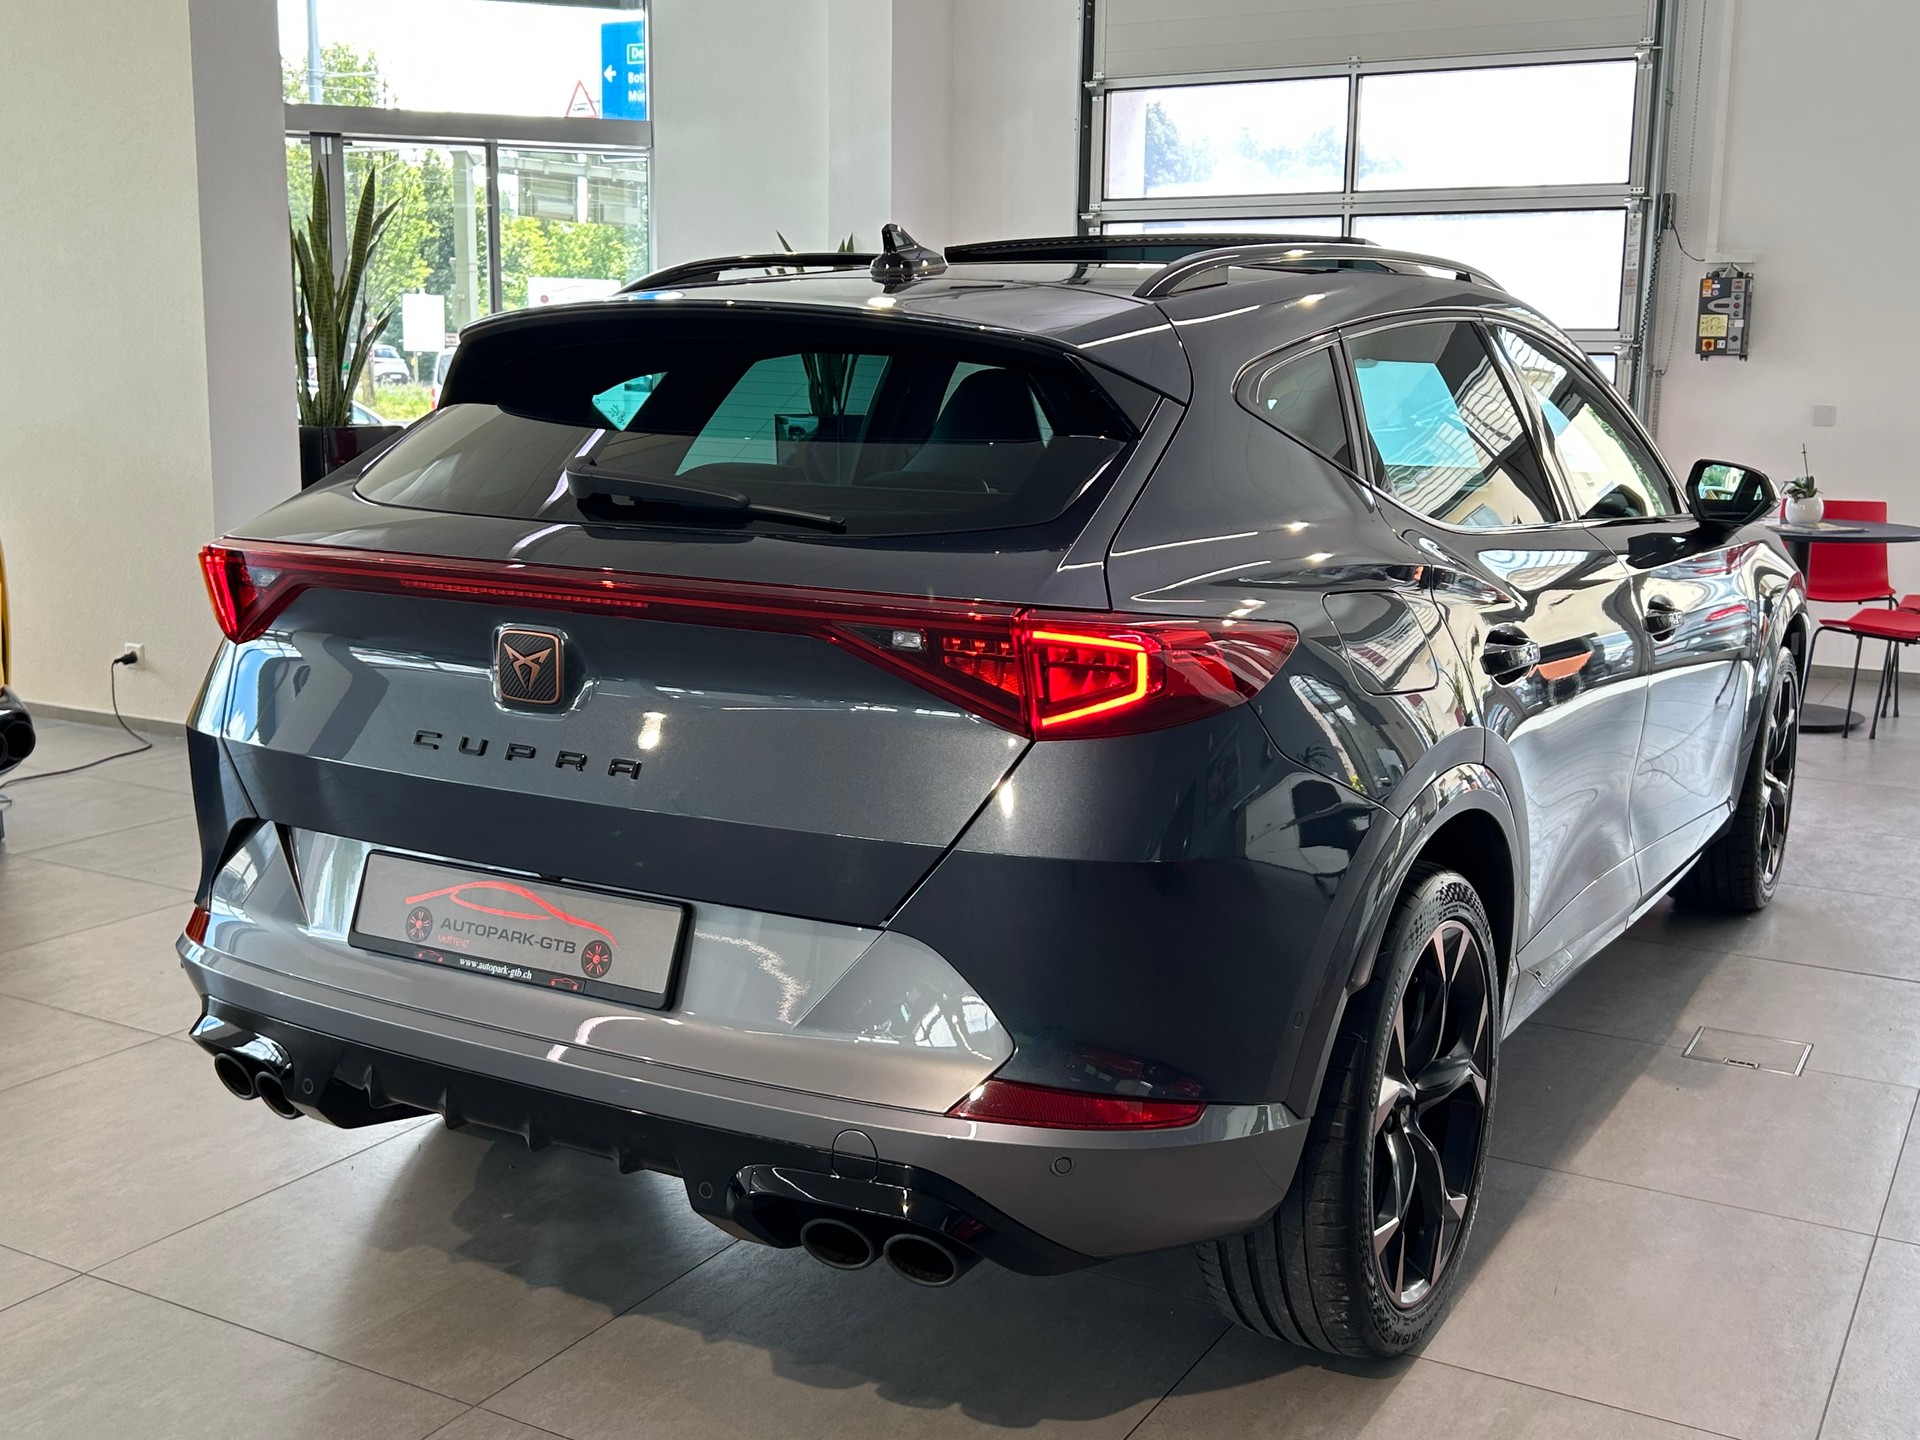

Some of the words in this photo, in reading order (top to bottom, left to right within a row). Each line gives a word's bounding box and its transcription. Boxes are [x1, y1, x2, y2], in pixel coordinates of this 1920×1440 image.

[413, 730, 642, 780] CUPRA
[440, 917, 577, 955] AUTOPARK-GTB
[459, 957, 533, 980] www.autopark-gtb.ch
